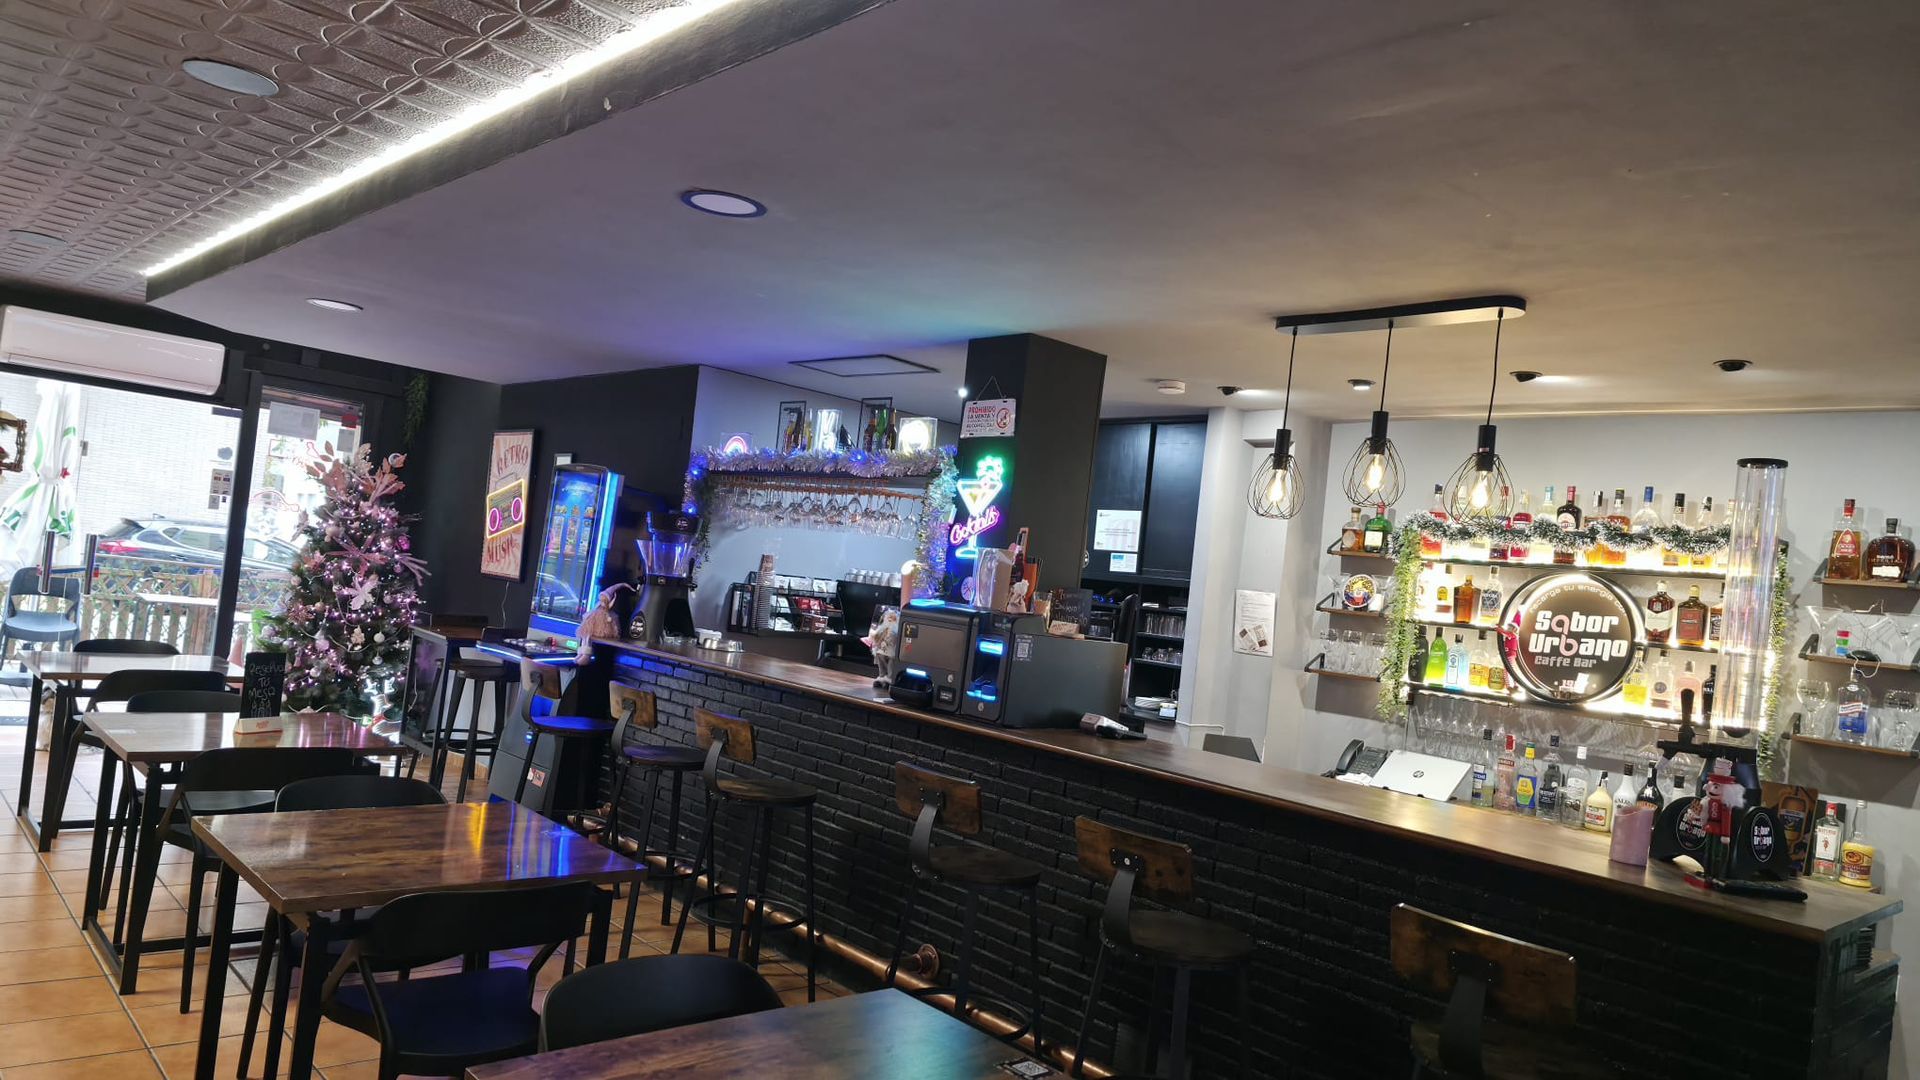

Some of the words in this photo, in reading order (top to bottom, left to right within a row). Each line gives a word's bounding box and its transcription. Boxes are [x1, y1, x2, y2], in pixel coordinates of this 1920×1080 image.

[497, 444, 529, 475] RETRO
[487, 533, 517, 563] MUSIC
[1535, 610, 1619, 635] Sabor
[1528, 632, 1629, 661] Urbano
[1534, 655, 1571, 667] Caffe
[1573, 657, 1597, 668] Bar
